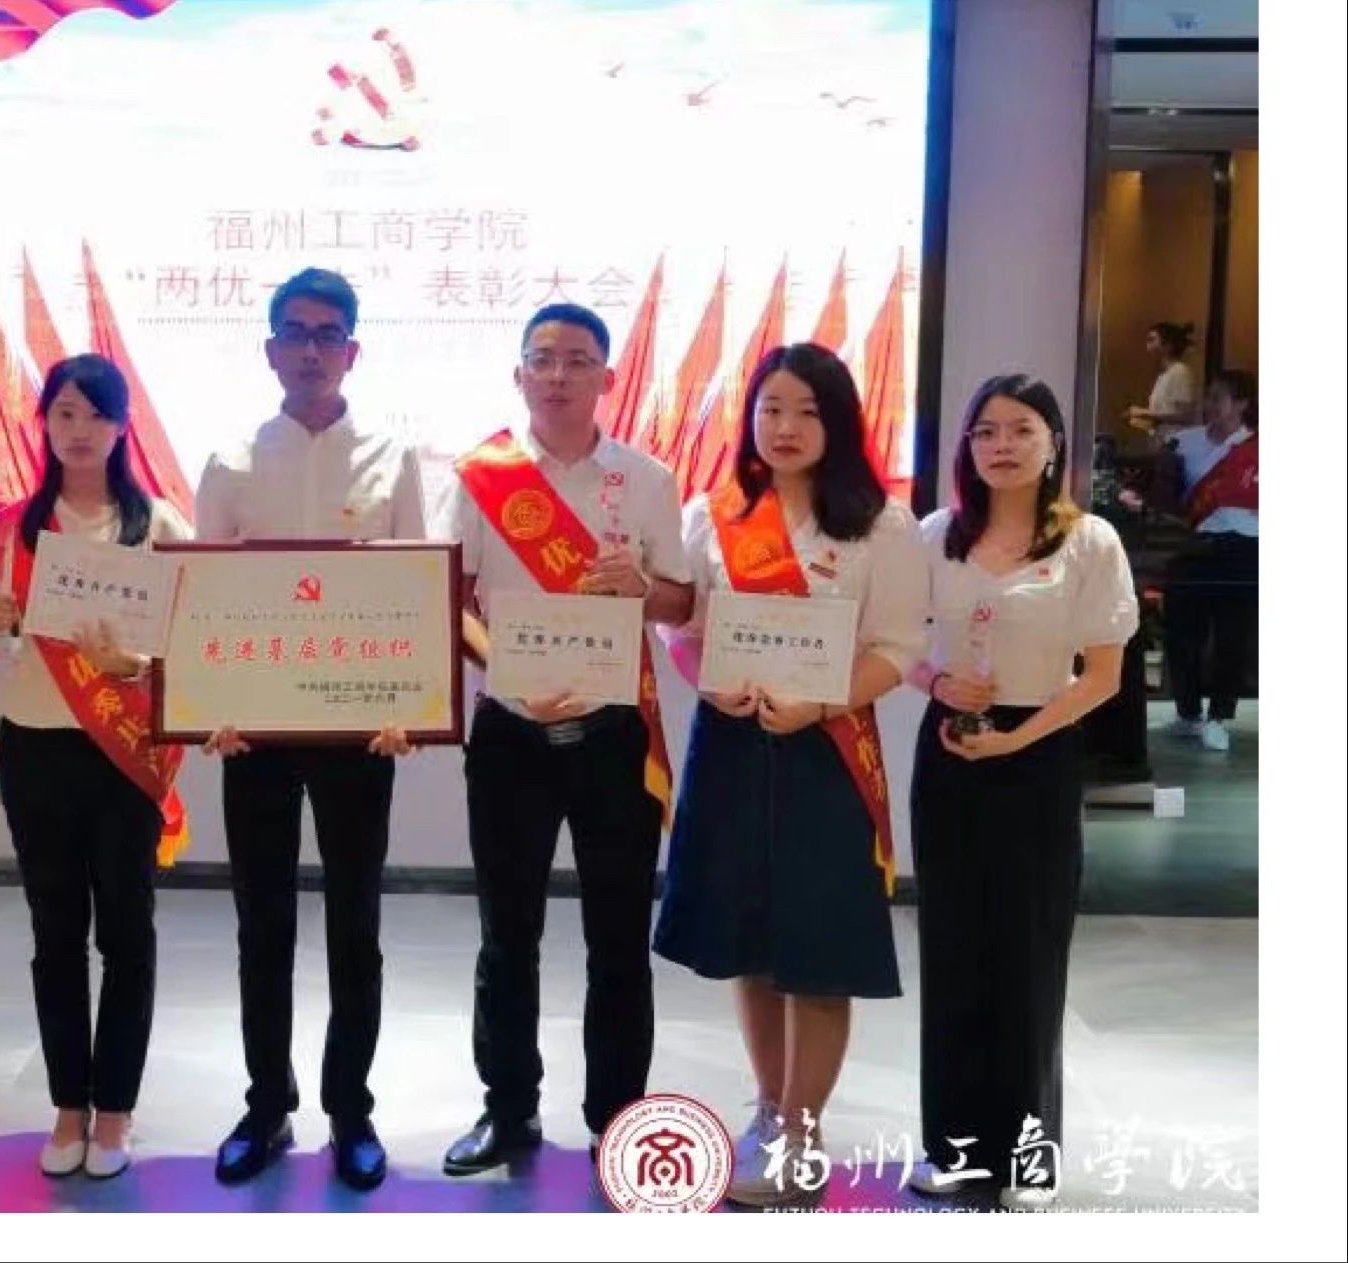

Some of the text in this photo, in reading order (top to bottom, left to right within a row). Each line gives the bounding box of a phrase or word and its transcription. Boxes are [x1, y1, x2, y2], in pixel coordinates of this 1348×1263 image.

[207, 207, 530, 252] 福州工商学院
[422, 263, 636, 309] 表彰大会
